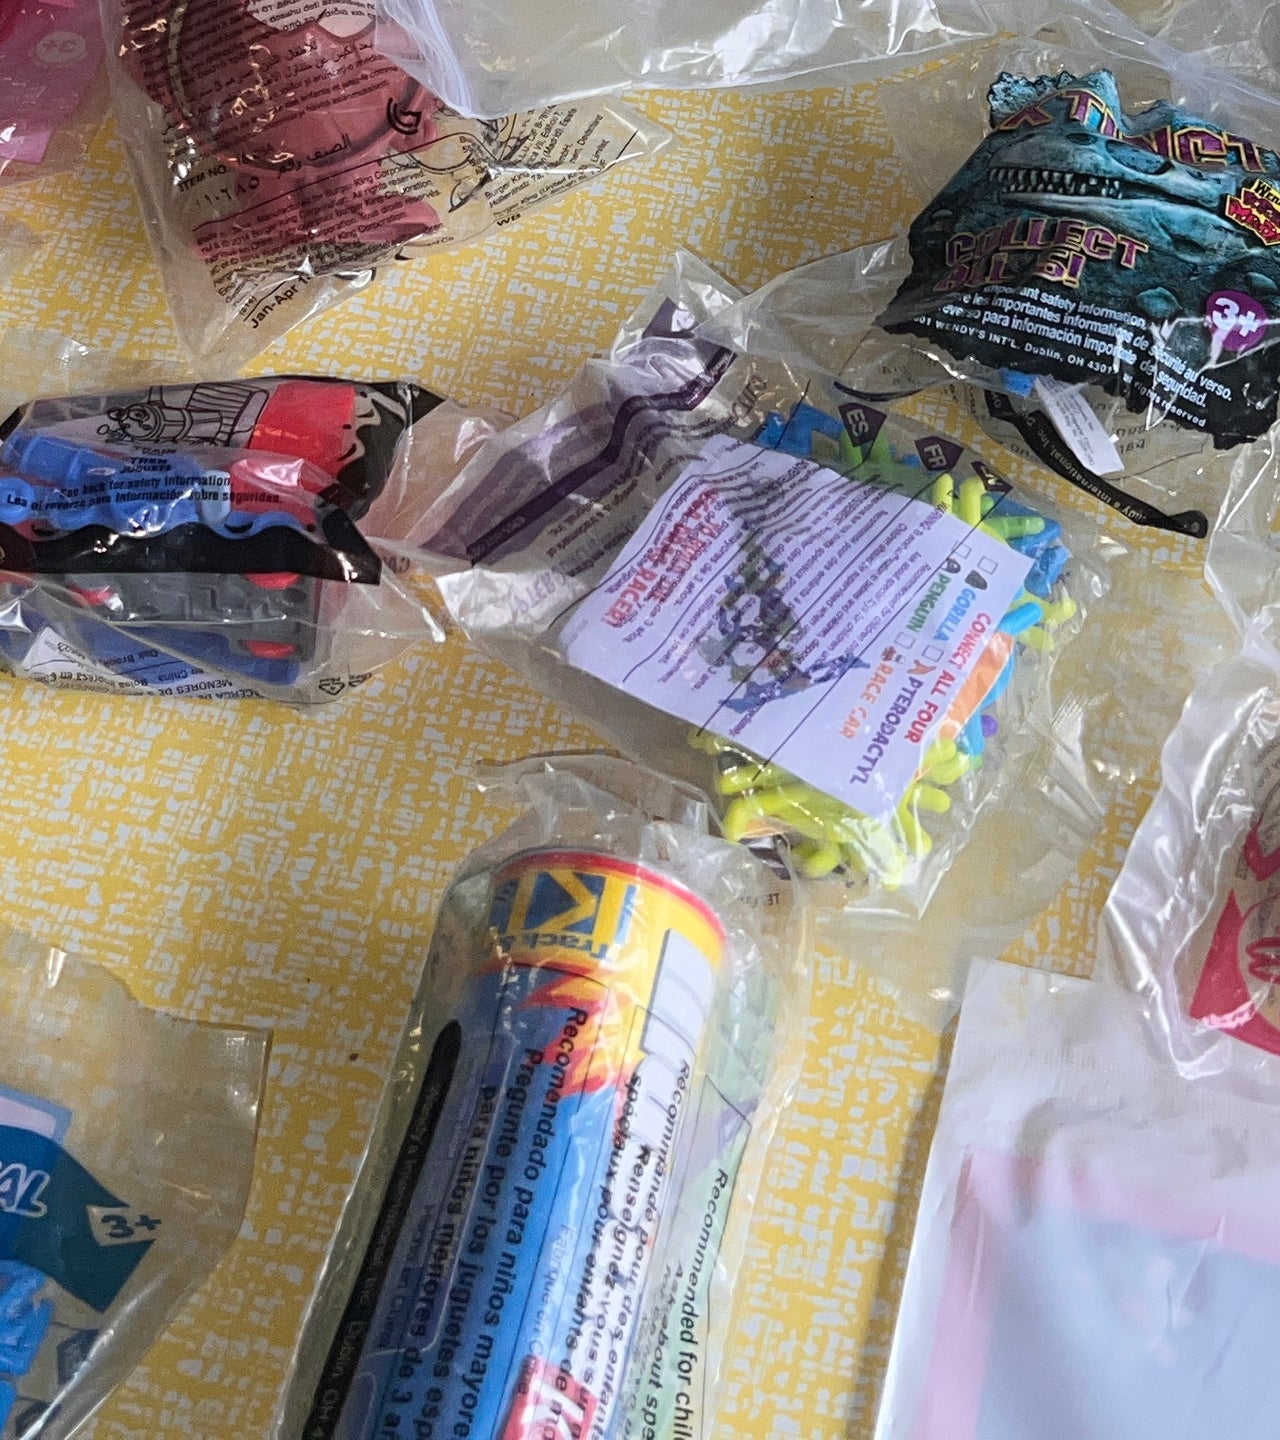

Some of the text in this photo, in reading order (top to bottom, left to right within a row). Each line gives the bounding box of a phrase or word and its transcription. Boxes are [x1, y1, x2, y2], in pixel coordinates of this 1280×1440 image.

[178, 162, 230, 192] ITEM NO.
[363, 182, 388, 198] rights
[484, 180, 512, 200] Burger
[944, 217, 1150, 271] COLLECT
[249, 282, 299, 329] Jan-Apr
[1038, 291, 1149, 330] safety information.
[1210, 295, 1268, 337] 3+
[981, 309, 1011, 329] para
[1010, 315, 1084, 347] información
[1155, 370, 1208, 408] seguridad.
[991, 294, 1063, 324] importantes
[1060, 313, 1134, 346] informations
[1198, 374, 1234, 401] verso.
[846, 409, 868, 436] ES
[128, 475, 162, 490] safety
[924, 443, 947, 467] FR
[7, 494, 28, 507] Lea
[600, 564, 658, 629] RACER!
[904, 572, 952, 633] PENGUIN
[932, 587, 978, 643] GORILLA
[860, 662, 895, 703] RACE
[903, 612, 992, 744] CONNECT ALL FOUR
[848, 676, 924, 787] PTERODACTYL
[470, 1083, 498, 1141] para
[521, 1007, 587, 1184] Recomendado
[444, 1142, 482, 1218] niños
[100, 1211, 162, 1239] 3+
[430, 1053, 542, 1382] Pregunte por los juguetes
[408, 1221, 458, 1339] menores
[482, 1186, 535, 1328] para niños
[584, 1142, 653, 1360] Renseignez-vous
[678, 1169, 728, 1384] Recommended for
[563, 1254, 598, 1350] enfants
[645, 1311, 675, 1390] about
